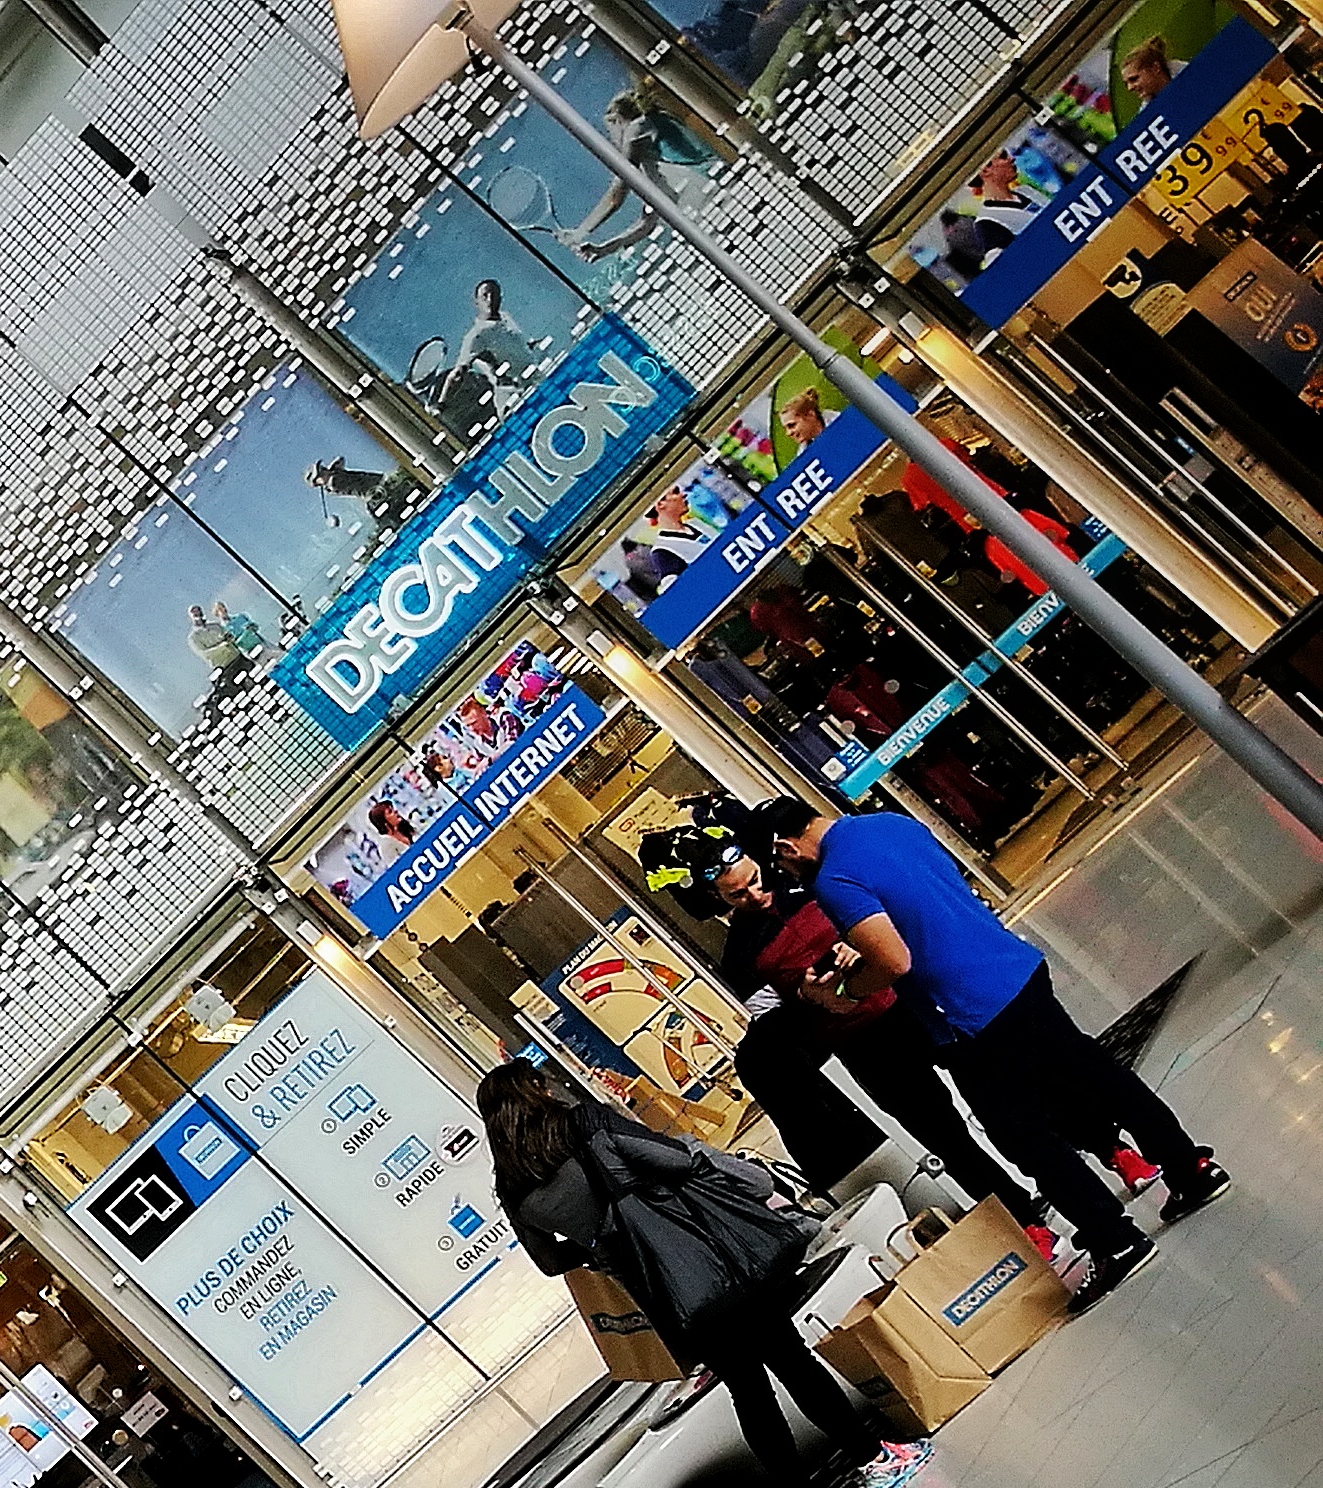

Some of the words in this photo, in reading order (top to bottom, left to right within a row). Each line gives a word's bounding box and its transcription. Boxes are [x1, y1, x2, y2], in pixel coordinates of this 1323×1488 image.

[303, 348, 660, 715] DECATHLON
[386, 809, 484, 913] ACCUEIL
[474, 702, 588, 821] INTERNET
[587, 920, 618, 949] MAGSIN
[222, 1016, 311, 1105] CLIQUEZ
[251, 1098, 282, 1131] &
[269, 1025, 357, 1112] RETIREZ
[341, 1106, 394, 1157] SIMPLE
[395, 1160, 444, 1207] RAPIDE
[175, 1268, 222, 1315] PLUS
[216, 1247, 245, 1276] DE
[239, 1200, 295, 1255] CHOIX
[212, 1234, 295, 1313] COMMANDEZ
[454, 1218, 509, 1272] GRATUIT
[239, 1295, 262, 1318] EN
[256, 1260, 302, 1302] LIGNE,
[258, 1279, 313, 1331] RETIREZ
[258, 1337, 282, 1360] EN
[276, 1284, 338, 1343] MAGASIN
[951, 1258, 1018, 1319] DECATHLON
